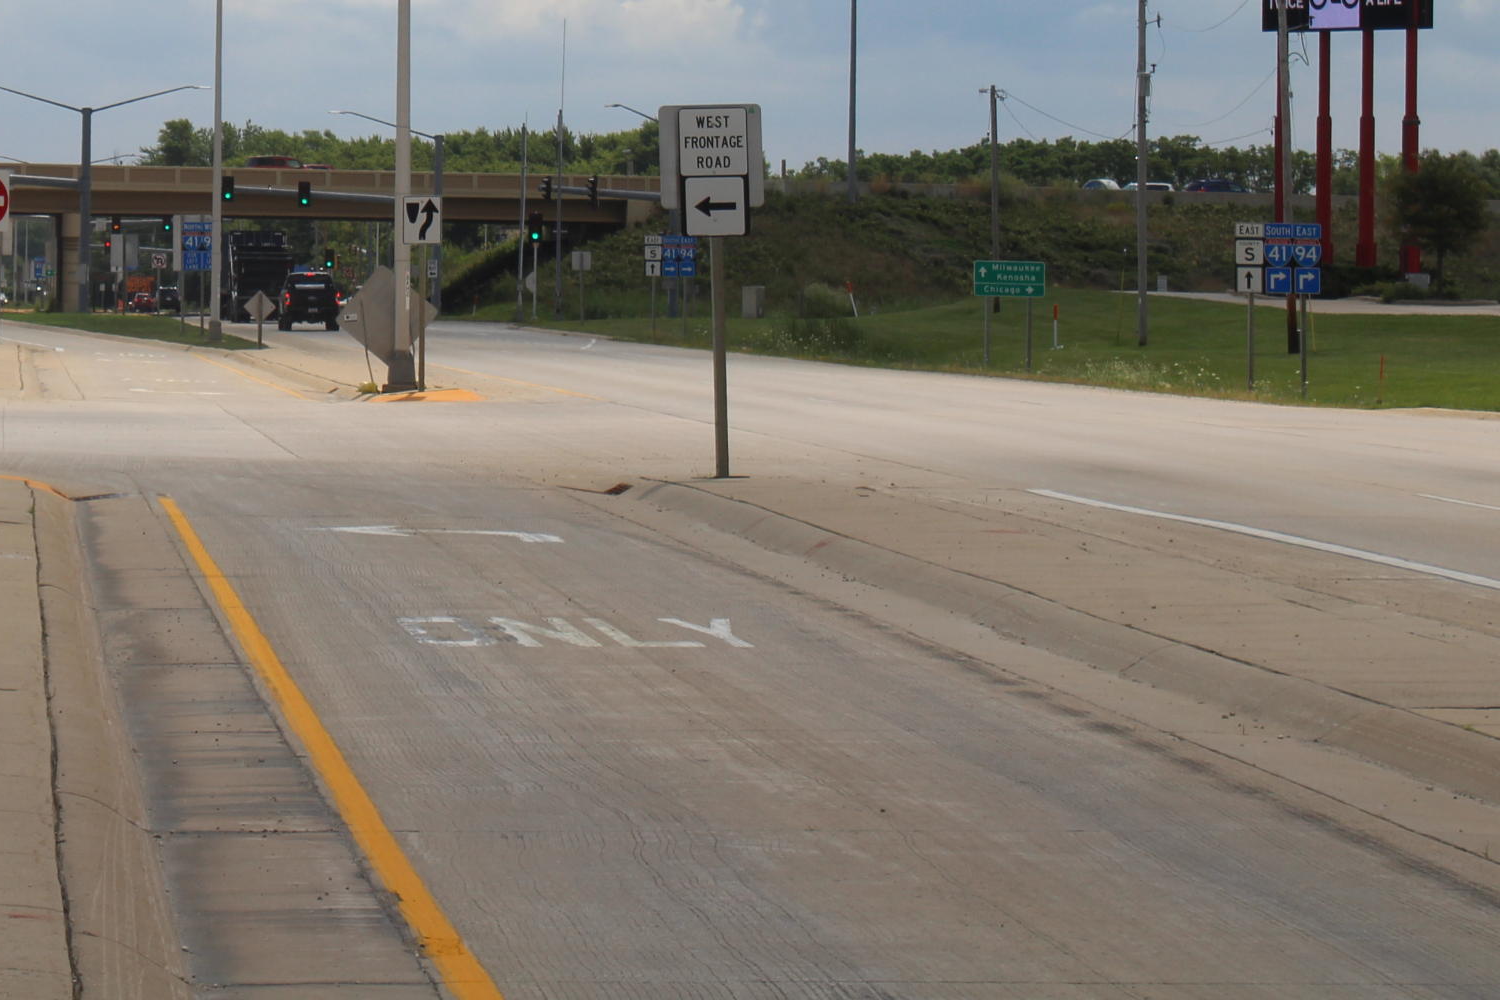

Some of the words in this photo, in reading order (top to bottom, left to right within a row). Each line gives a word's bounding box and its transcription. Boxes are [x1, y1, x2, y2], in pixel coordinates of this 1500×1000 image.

[696, 115, 730, 128] WEST
[684, 135, 743, 149] FRONTAGE
[697, 155, 731, 168] ROAD
[1239, 225, 1259, 235] EAST
[1266, 225, 1291, 236] SOUTH
[1296, 226, 1317, 236] EAST
[650, 249, 657, 258] S
[1244, 247, 1255, 261] S
[1268, 246, 1286, 262] 41
[1294, 246, 1317, 262] 94
[996, 273, 1036, 281] Kenosha
[983, 285, 1021, 295] Chicago
[396, 615, 755, 648] ONLY
